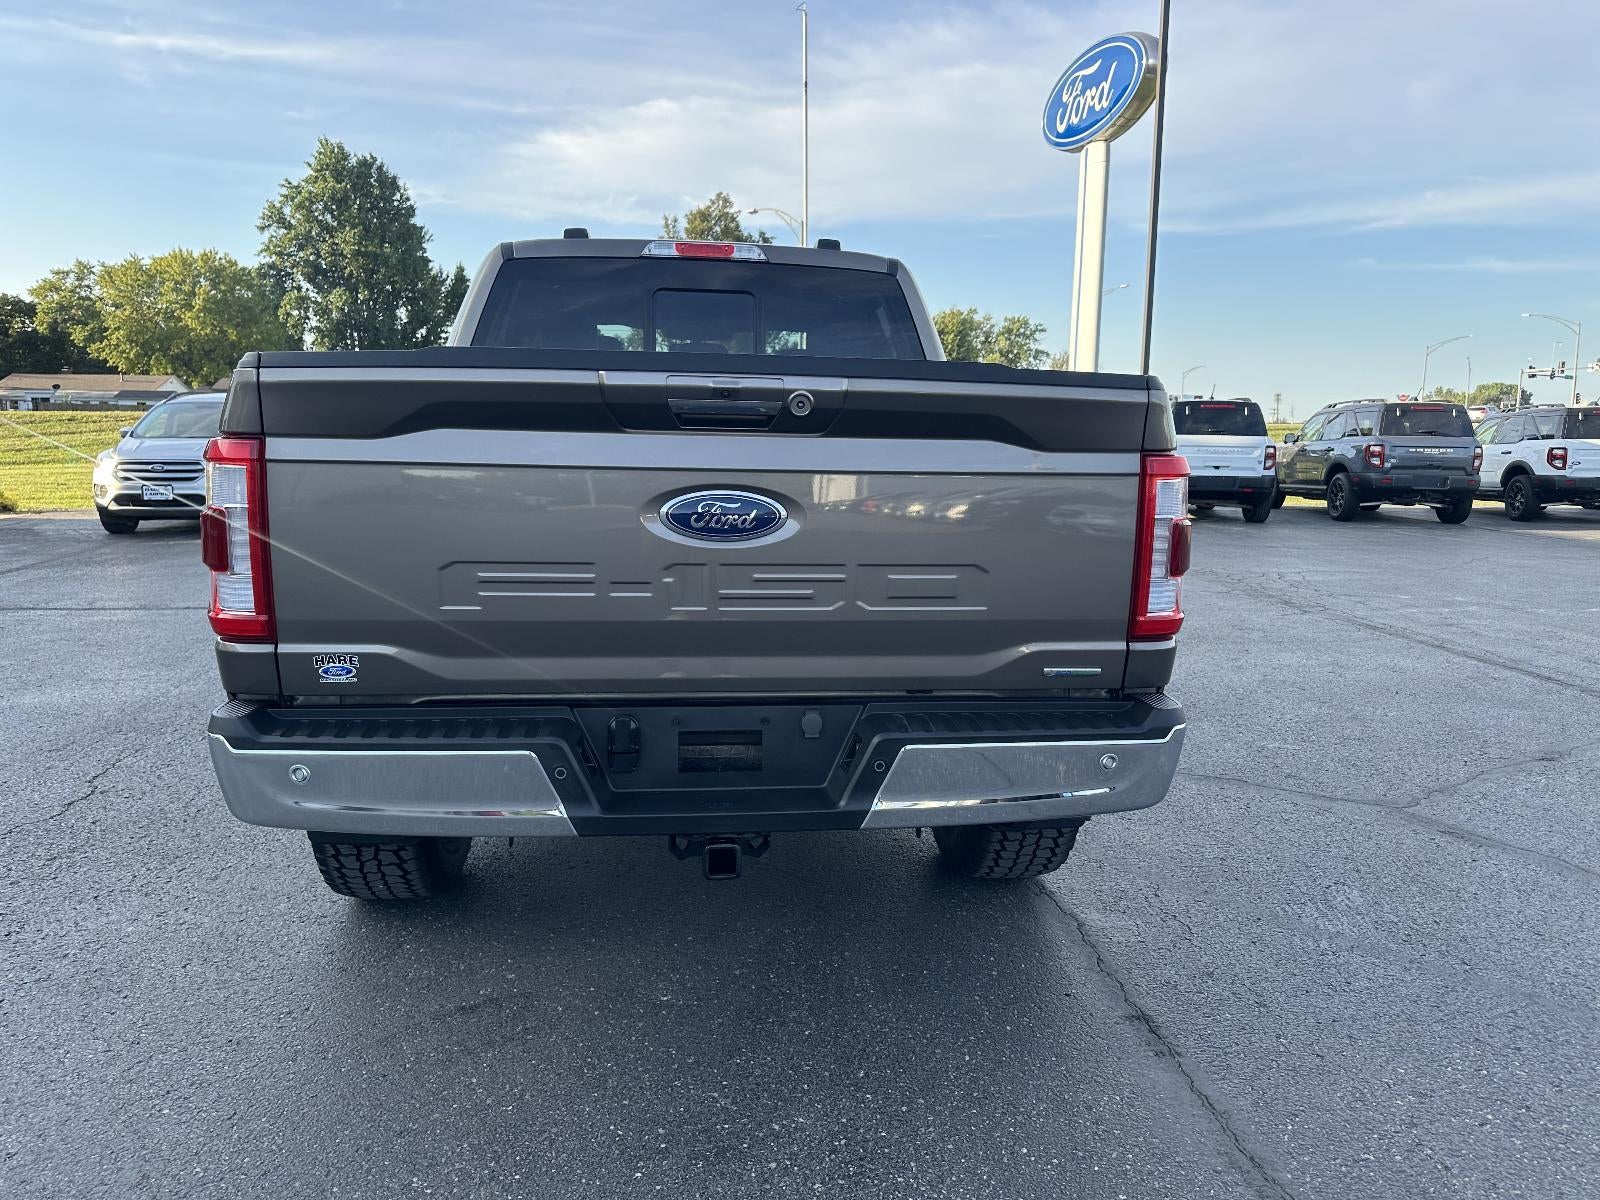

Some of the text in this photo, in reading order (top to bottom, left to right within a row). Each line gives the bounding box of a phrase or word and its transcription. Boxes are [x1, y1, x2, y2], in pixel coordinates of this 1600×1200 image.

[1056, 58, 1117, 133] Ford
[690, 500, 758, 529] Ford
[438, 560, 990, 611] F-150
[313, 653, 360, 668] HARE
